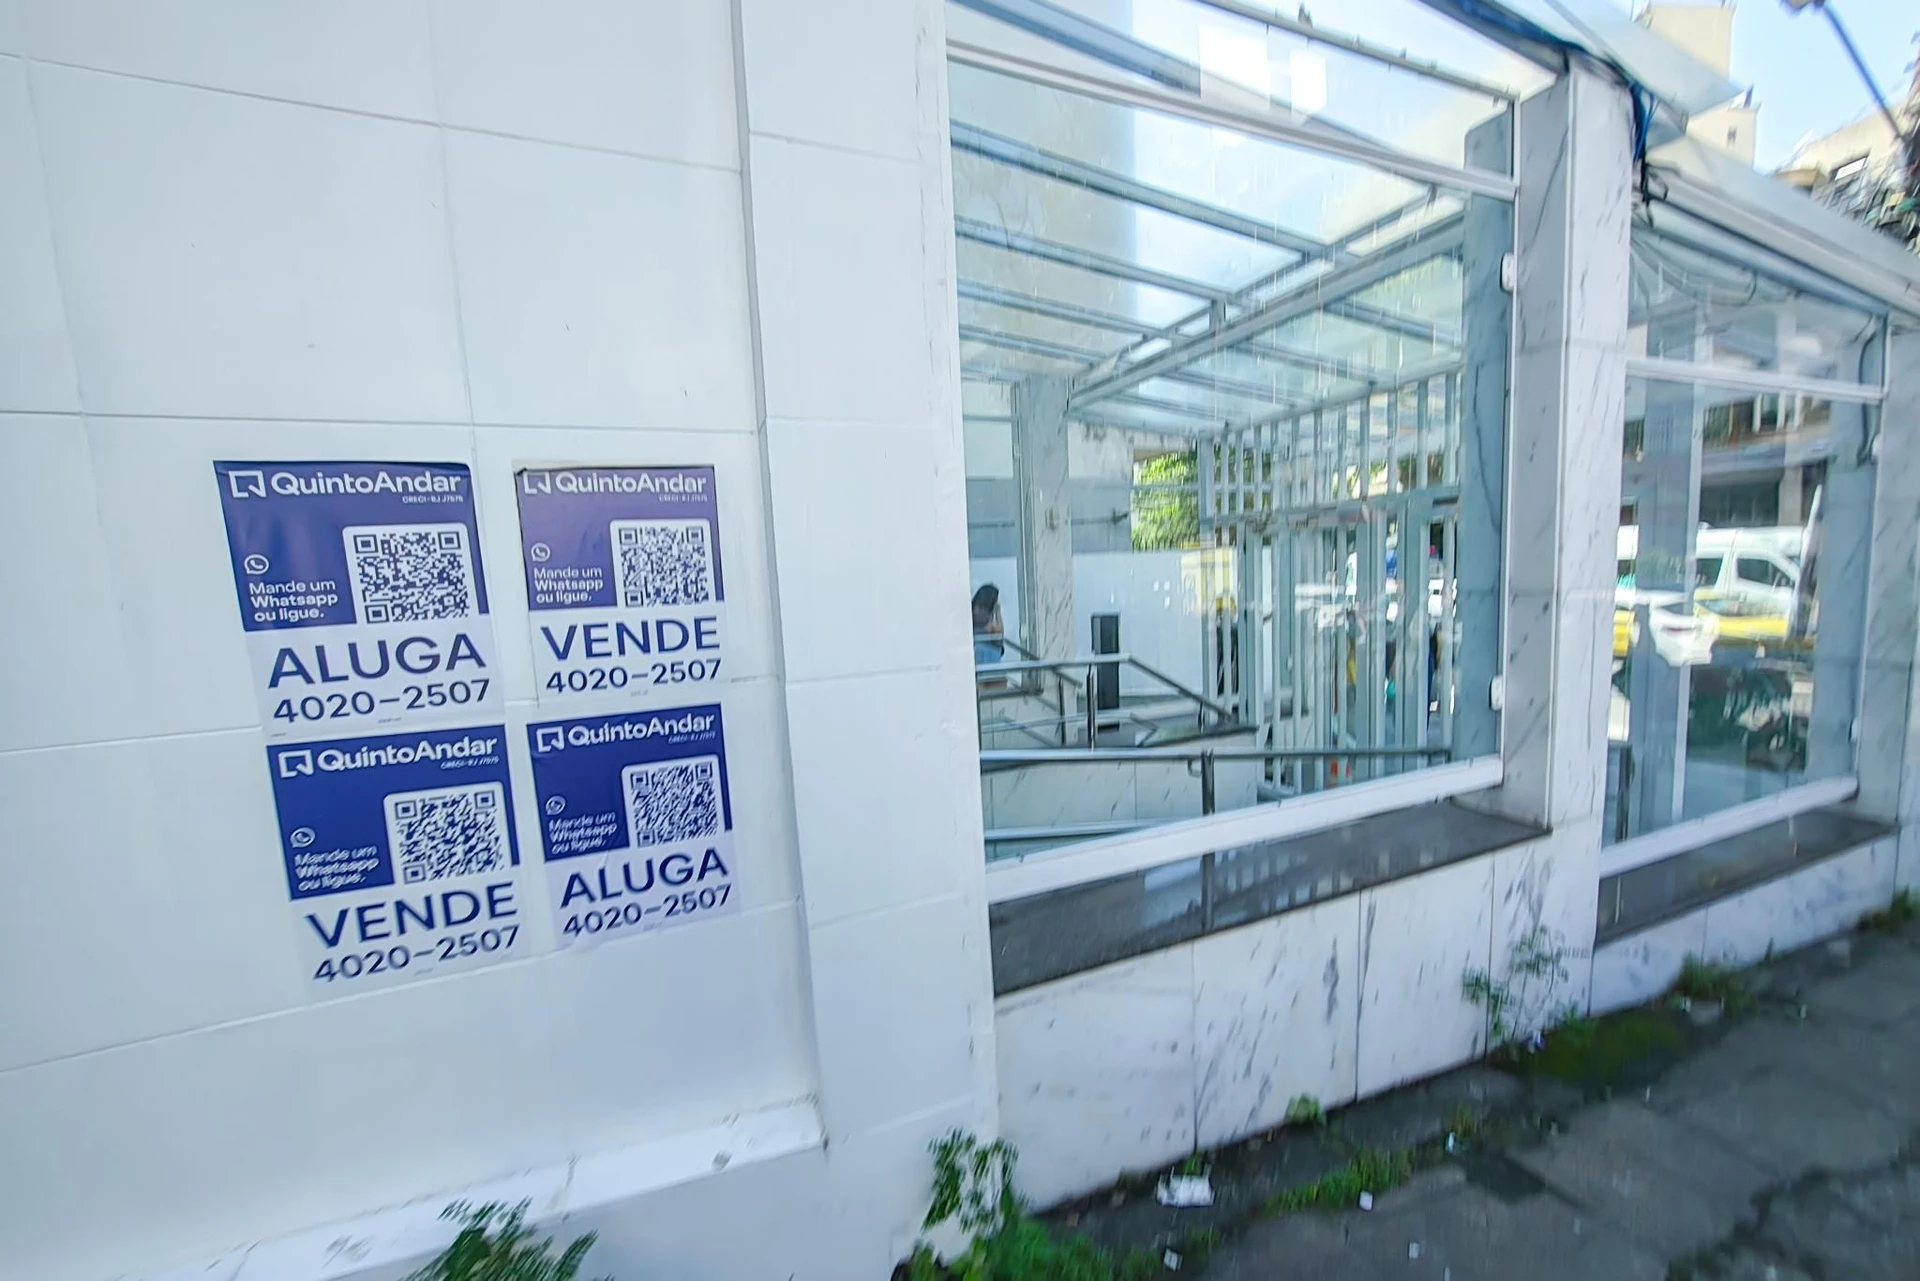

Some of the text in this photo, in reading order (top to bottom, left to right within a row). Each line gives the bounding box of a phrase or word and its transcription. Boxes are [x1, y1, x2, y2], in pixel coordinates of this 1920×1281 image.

[271, 471, 462, 496] QuintoAndar
[555, 472, 708, 494] QuintoAndar
[248, 580, 336, 595] Mande um
[534, 566, 603, 580] Mande um
[534, 579, 604, 593] Whatsapp
[250, 593, 339, 609] Whatsapp
[536, 592, 554, 604] ou
[254, 607, 325, 623] ou ligue.
[540, 615, 721, 662] VENDE
[267, 633, 487, 690] ALUGA
[545, 658, 723, 694] 4020-2507
[273, 678, 491, 724] 4020-2507
[568, 713, 715, 747] QuintoAndar
[317, 736, 498, 772] QuintoAndar
[351, 845, 378, 860] um
[298, 878, 321, 892] ou
[559, 847, 729, 910] ALUGA
[304, 881, 519, 949] VENDE
[562, 883, 732, 938] 4020-2507
[312, 924, 521, 983] 4020-2507
